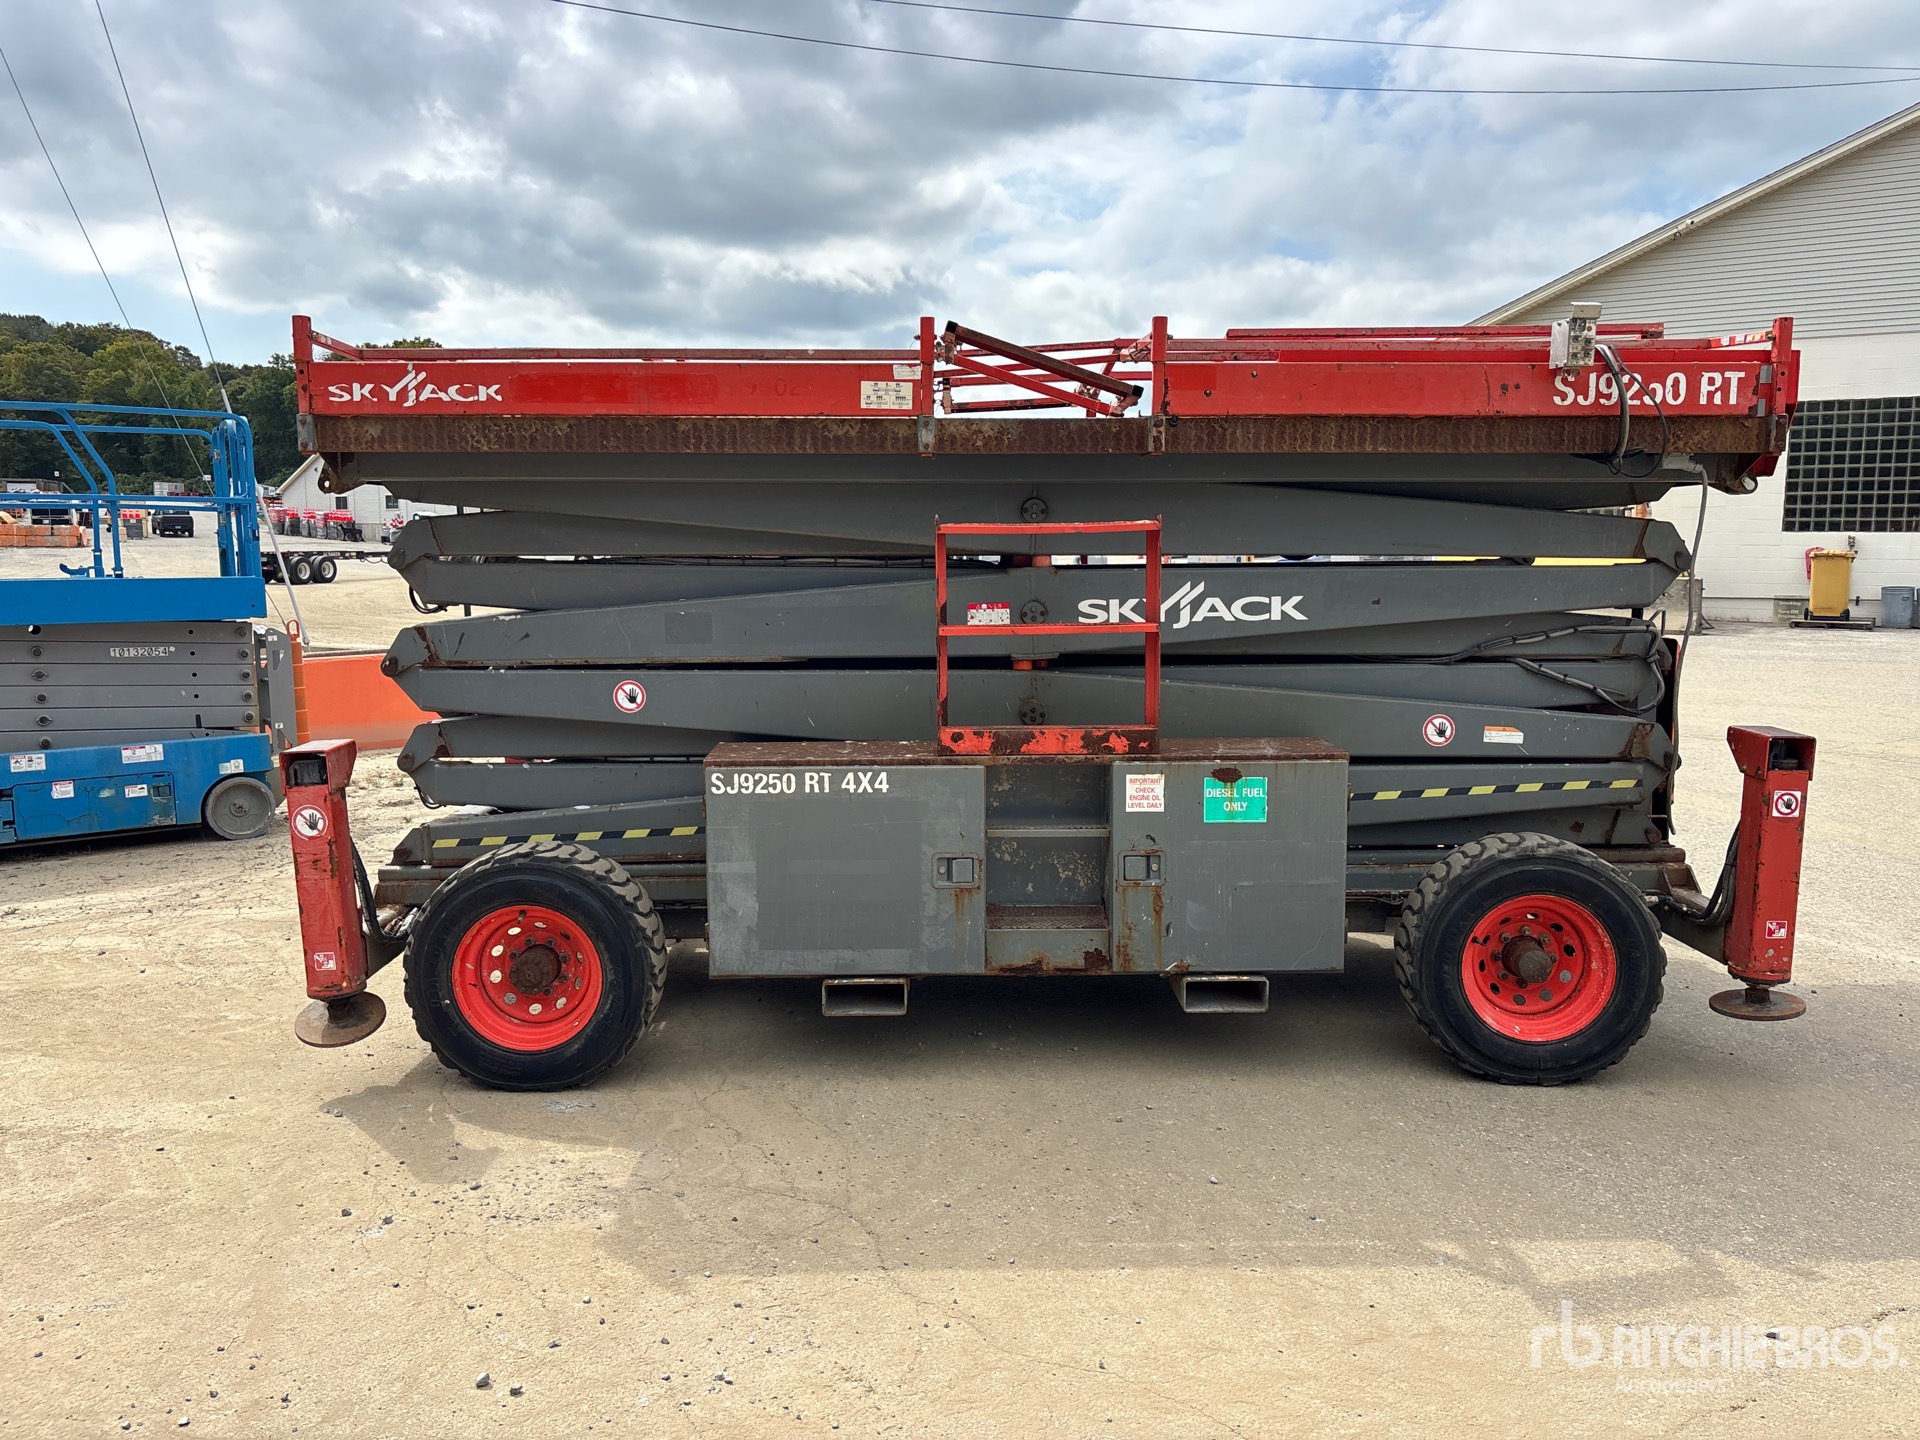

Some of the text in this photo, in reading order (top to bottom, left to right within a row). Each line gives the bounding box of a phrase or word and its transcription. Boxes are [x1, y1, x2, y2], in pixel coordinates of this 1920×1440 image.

[328, 368, 502, 407] SKYJACK
[1699, 371, 1746, 405] RT
[110, 647, 168, 657] 10132054
[710, 771, 889, 794] SJ9250 RT 4X4
[1206, 787, 1265, 798] DIESEL FUEL
[1223, 801, 1248, 811] ONLY
